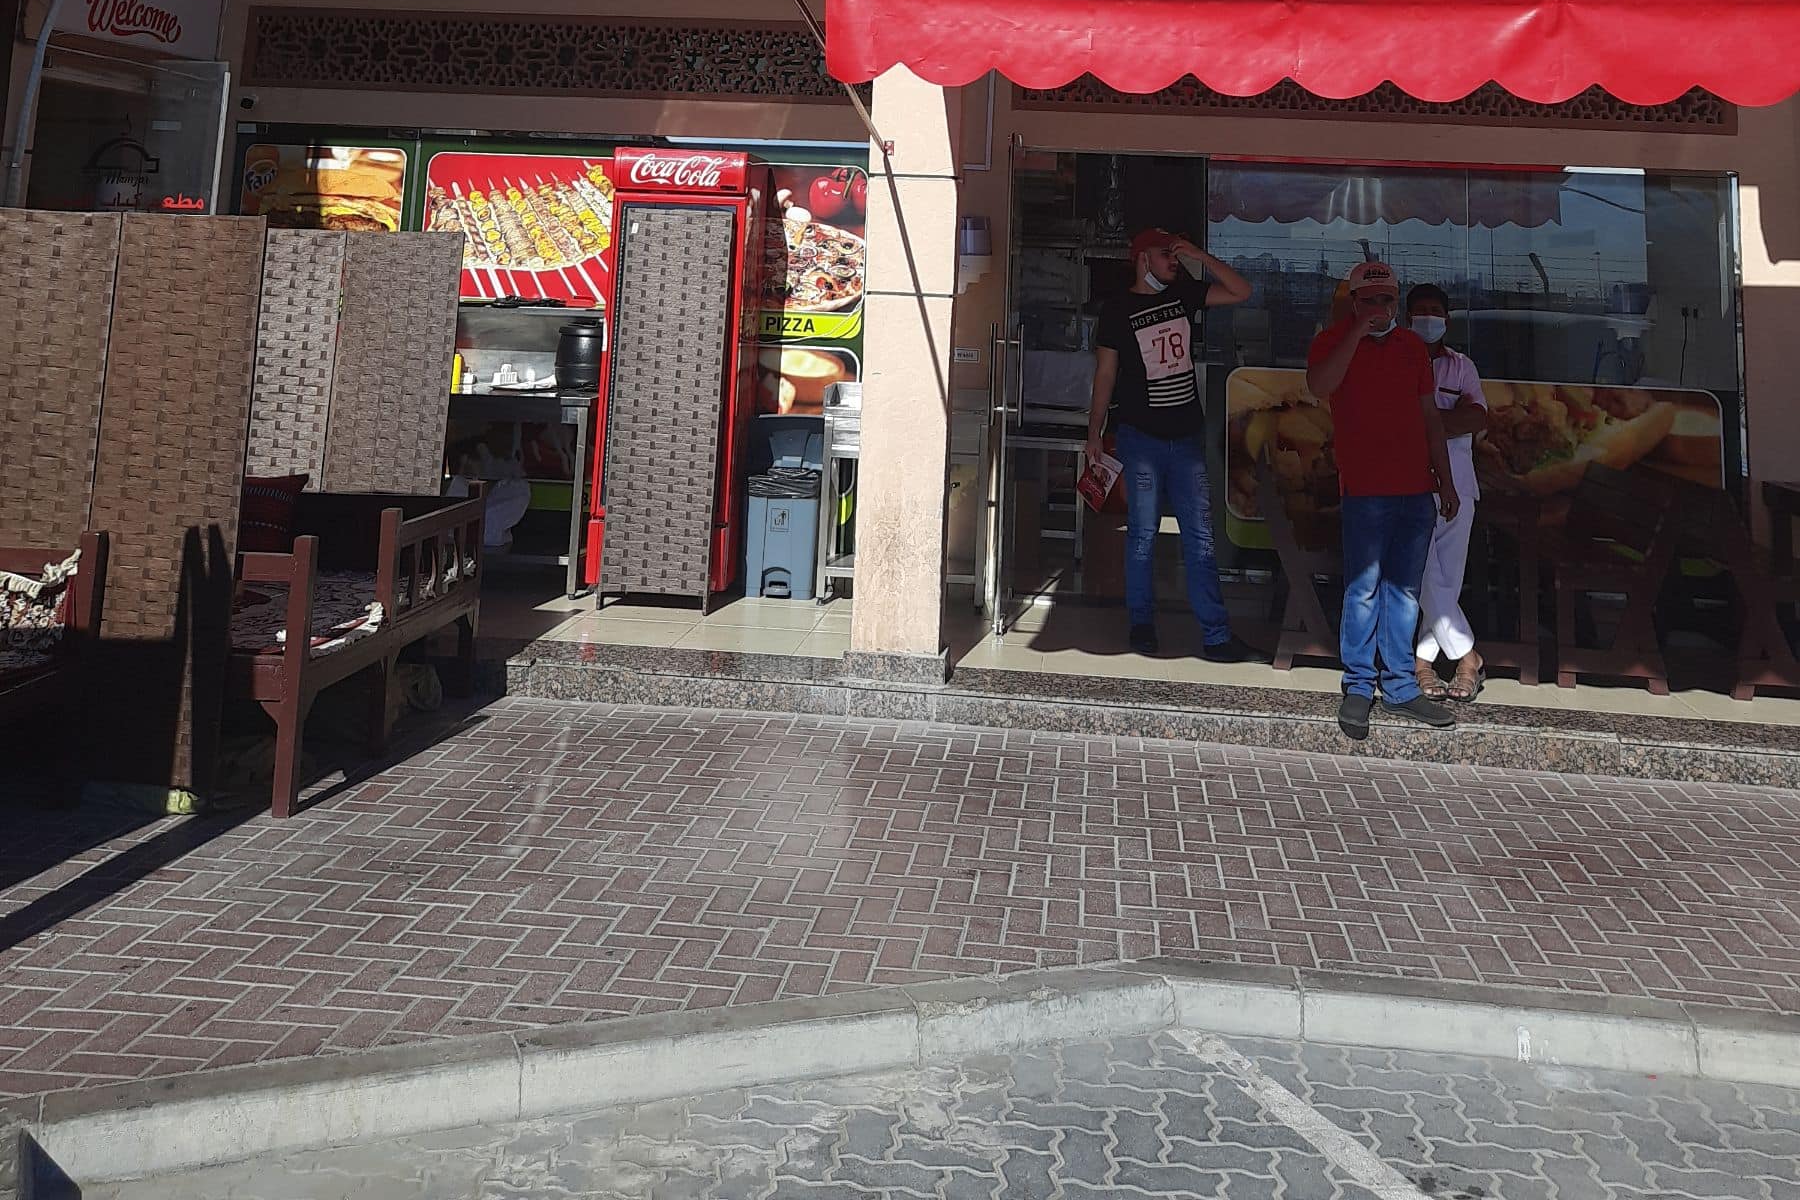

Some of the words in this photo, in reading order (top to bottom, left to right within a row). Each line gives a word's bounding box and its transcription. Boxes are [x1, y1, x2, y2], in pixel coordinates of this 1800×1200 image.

[630, 153, 727, 187] Coca-Cola
[765, 316, 815, 333] PIZZA
[1151, 332, 1185, 364] 78
